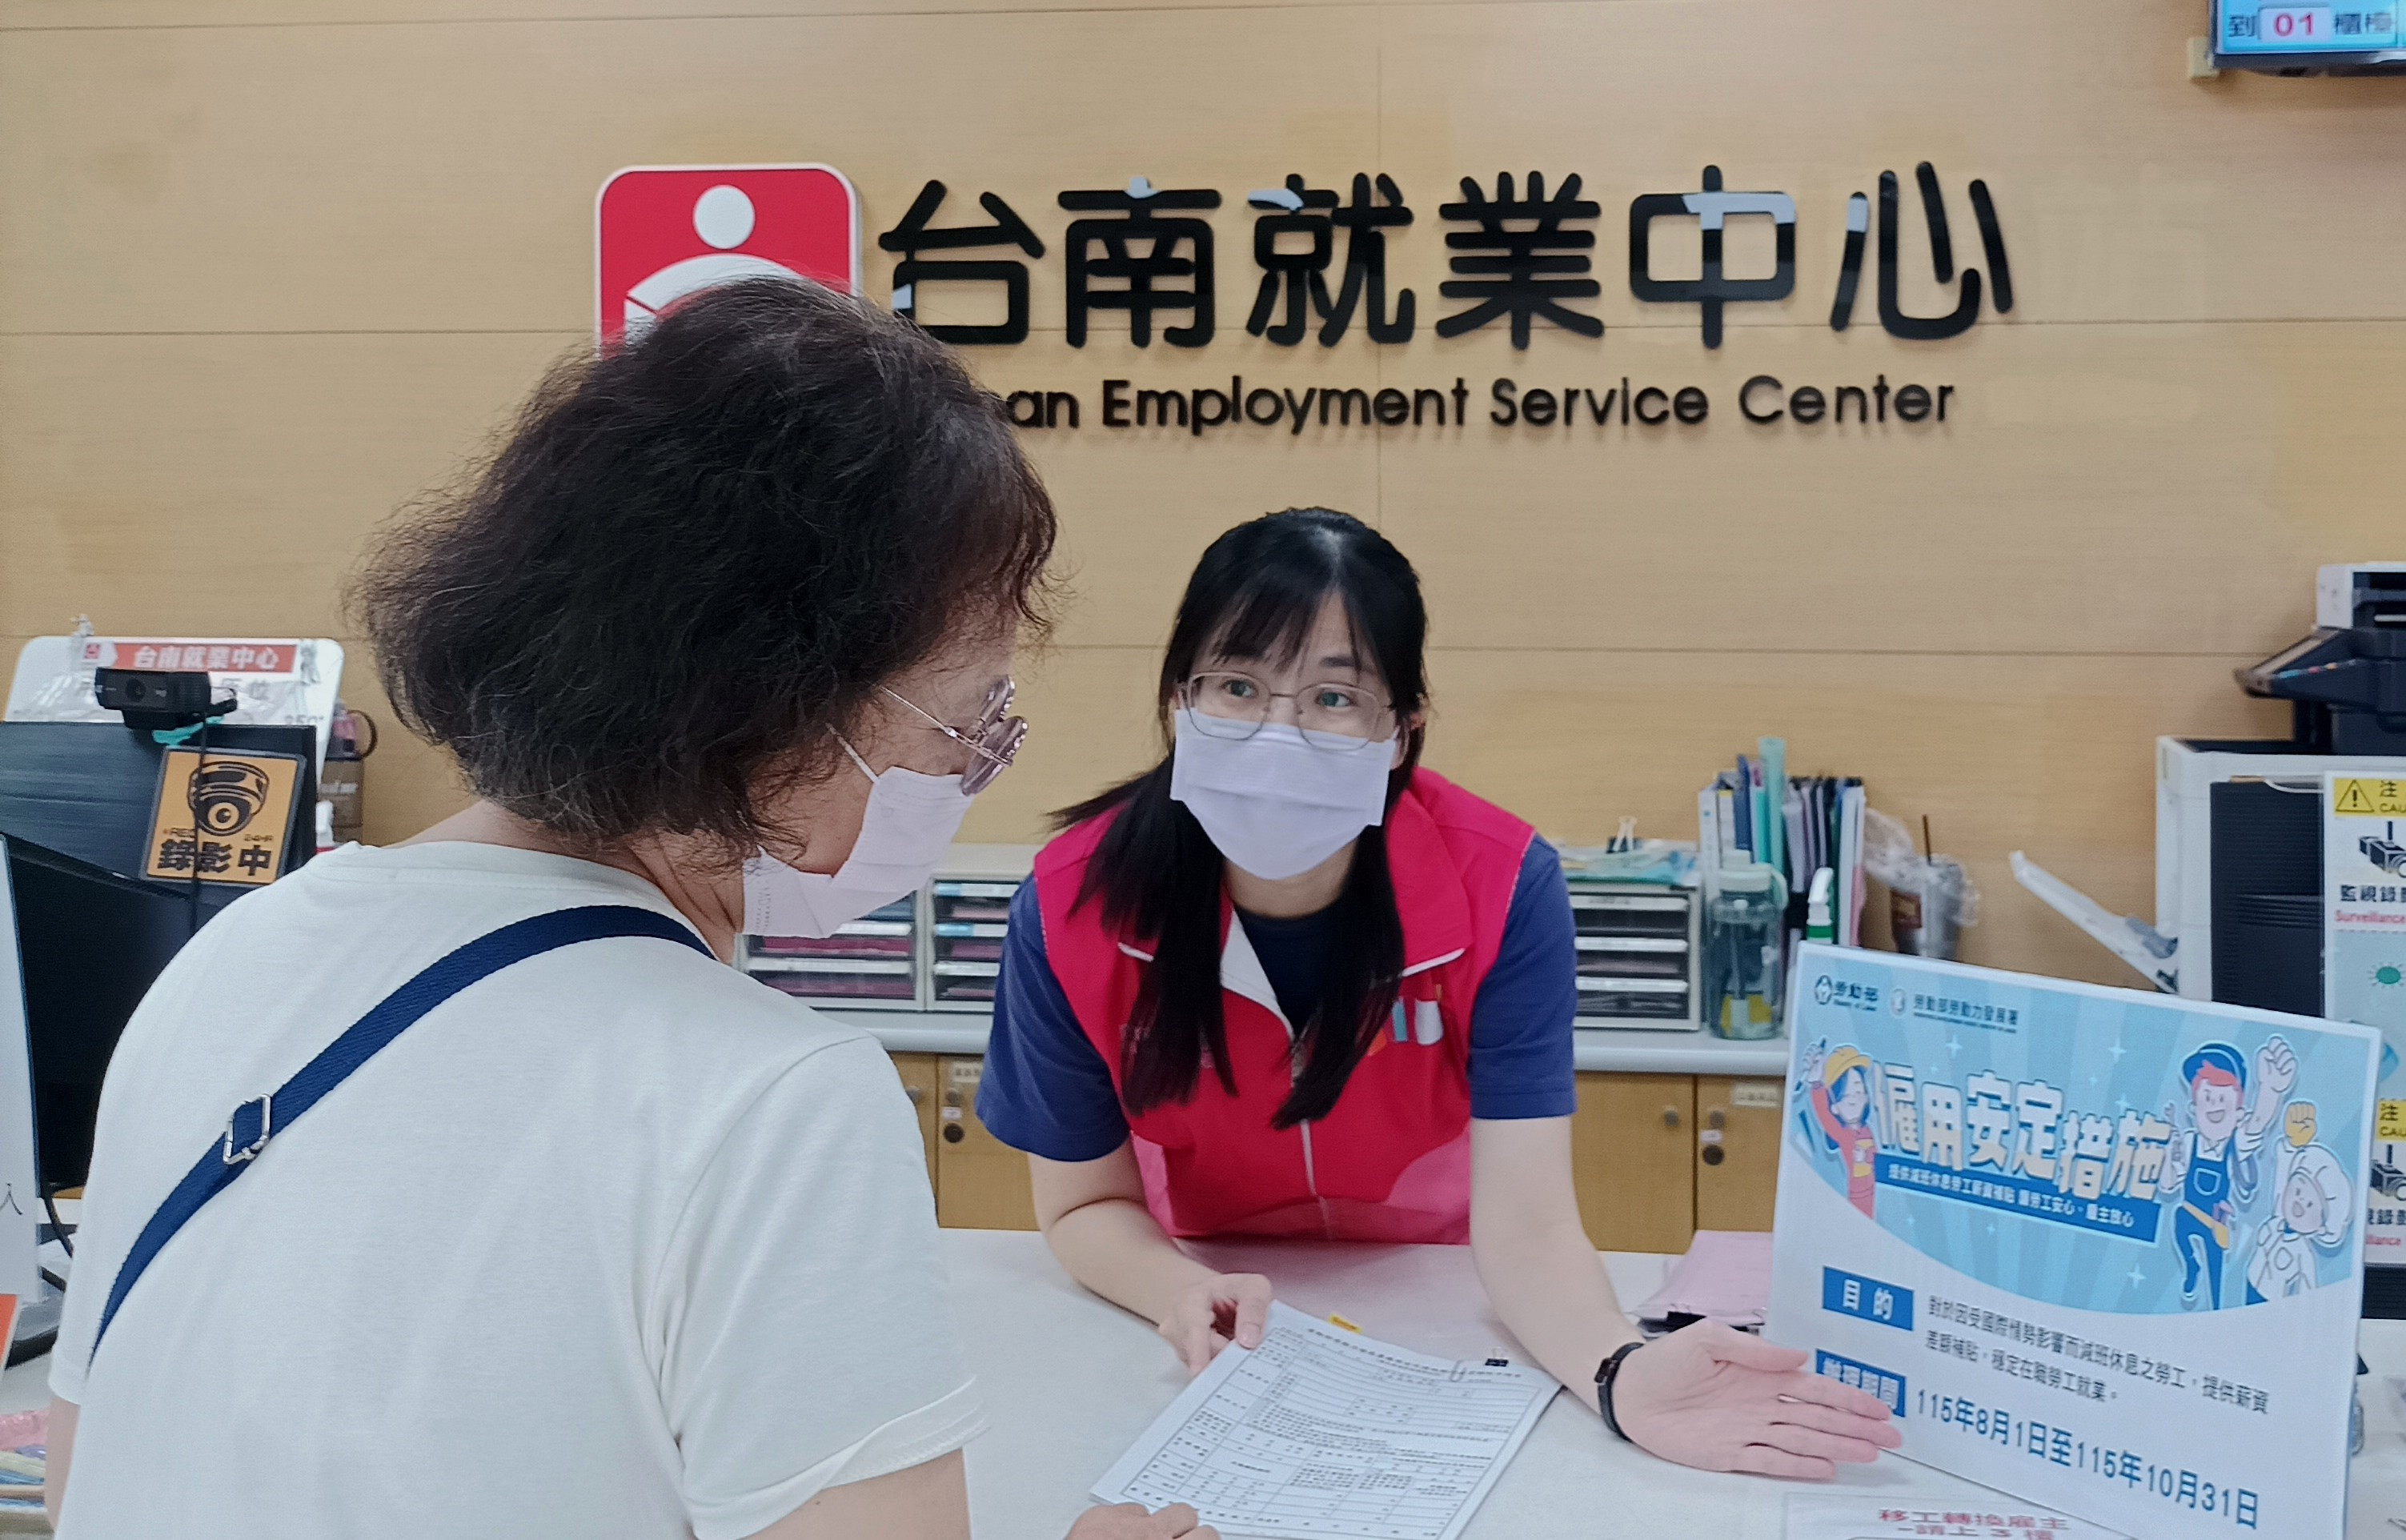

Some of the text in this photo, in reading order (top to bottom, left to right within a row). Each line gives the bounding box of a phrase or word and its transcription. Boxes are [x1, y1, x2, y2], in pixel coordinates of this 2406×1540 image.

[2274, 13, 2316, 37] 01
[879, 162, 2014, 351] 台南就業中心
[1101, 375, 1469, 435] Employment
[1490, 377, 1709, 427] Service
[1738, 374, 1955, 425] Center
[134, 645, 280, 670] 台南就業中心
[157, 839, 272, 876] 錄影中
[1843, 1278, 1894, 1321] 目的
[1919, 1389, 2259, 1530] 115年8月1日至115年10月31日
